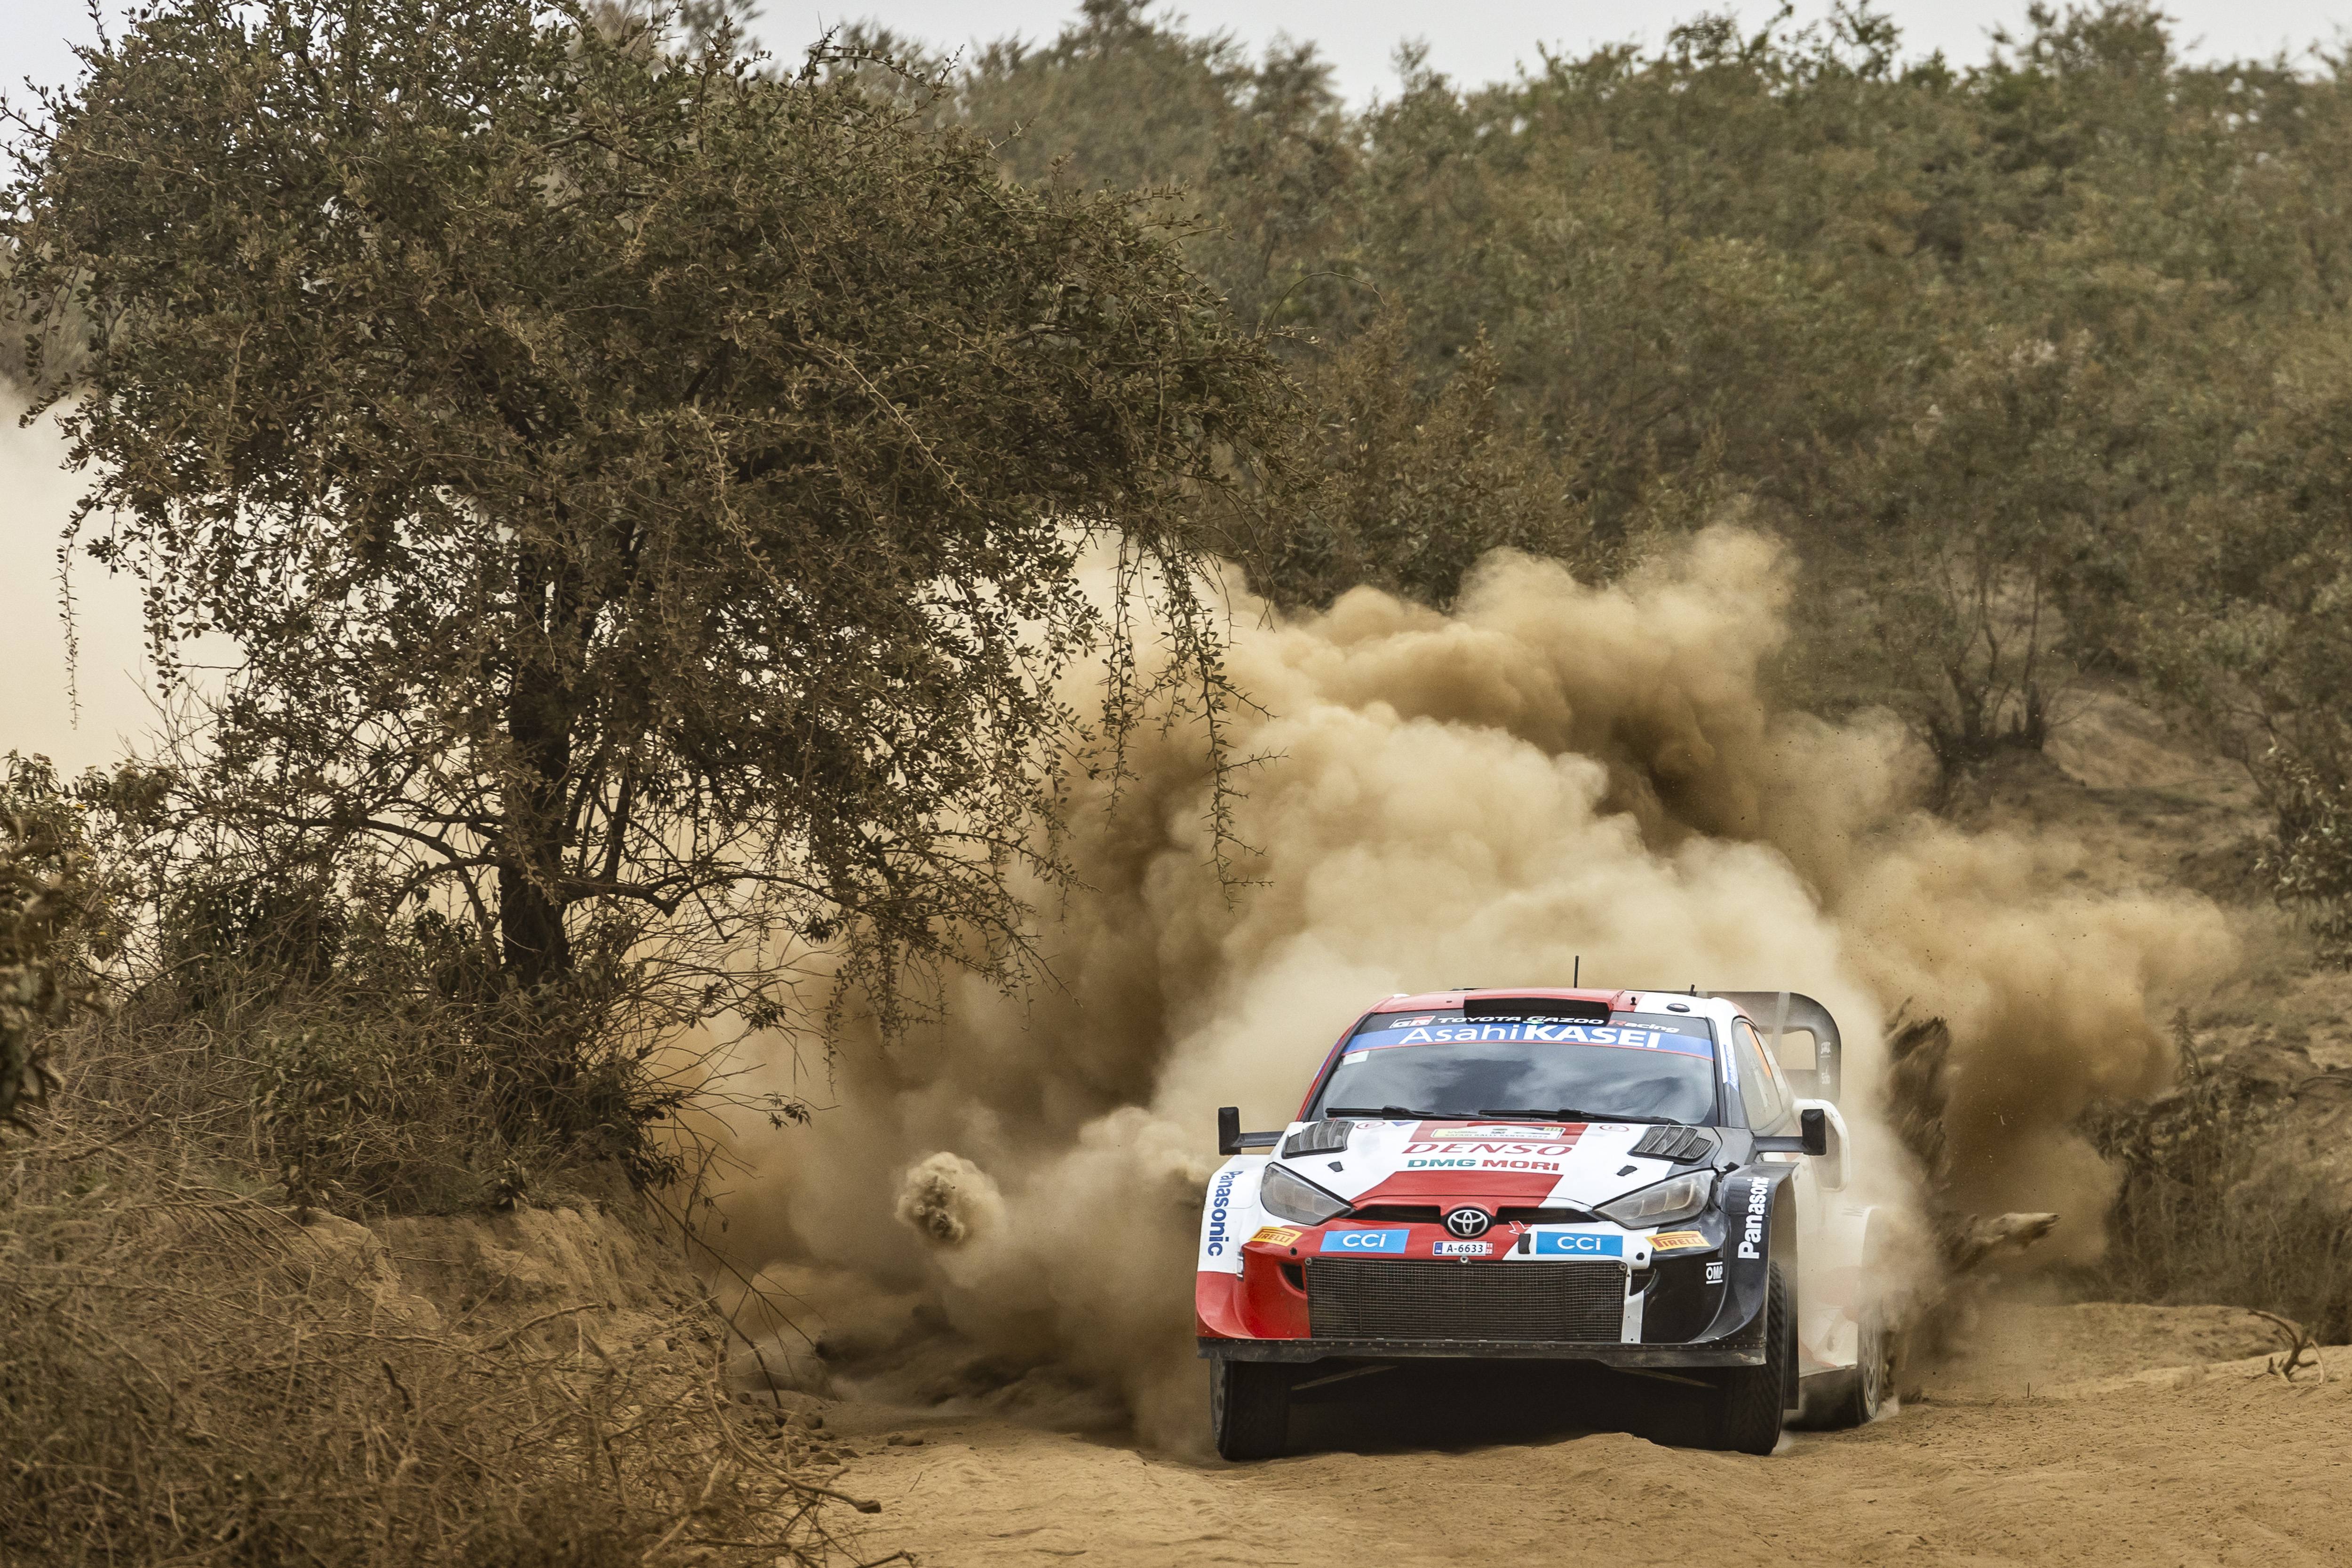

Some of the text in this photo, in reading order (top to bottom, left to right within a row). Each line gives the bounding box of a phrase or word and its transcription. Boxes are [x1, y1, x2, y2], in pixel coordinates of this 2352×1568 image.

[1609, 1019, 1680, 1033] Racing
[1401, 1144, 1573, 1155] DENSO
[1482, 1160, 1560, 1170] MORI
[1208, 1170, 1244, 1256] Panasonic
[1253, 1229, 1295, 1243] PIRELLI
[1651, 1234, 1704, 1248] PIRELLI
[1446, 1244, 1483, 1253] A-6633
[1706, 1266, 1723, 1280] OMP
